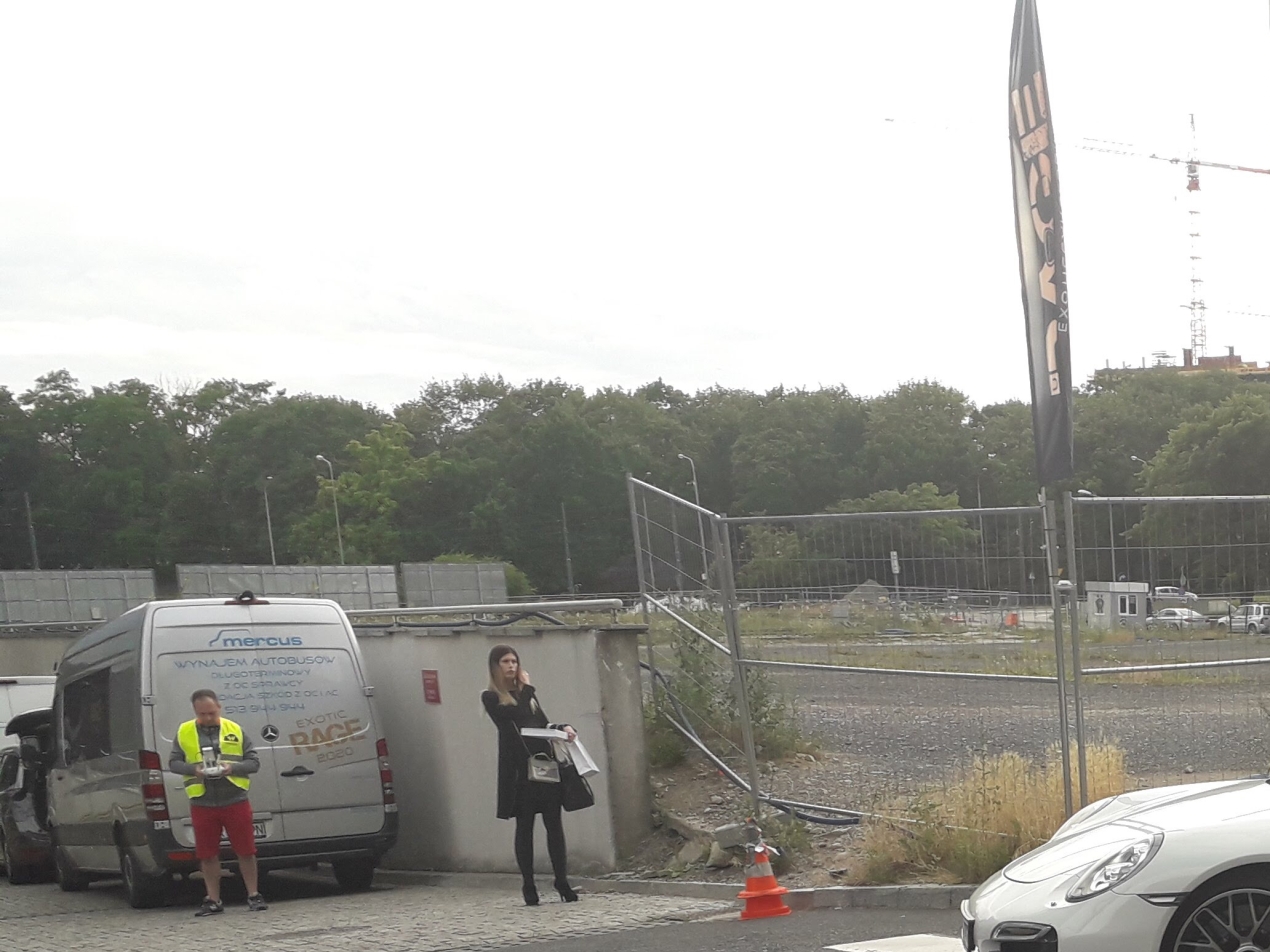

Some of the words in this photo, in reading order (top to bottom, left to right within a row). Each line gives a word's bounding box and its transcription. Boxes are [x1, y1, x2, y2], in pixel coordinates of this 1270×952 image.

[222, 636, 303, 647] mercus
[174, 658, 248, 669] WYNAJEM
[224, 705, 247, 715] 513
[296, 710, 348, 729] EXOTIC
[316, 747, 355, 764] 2020
